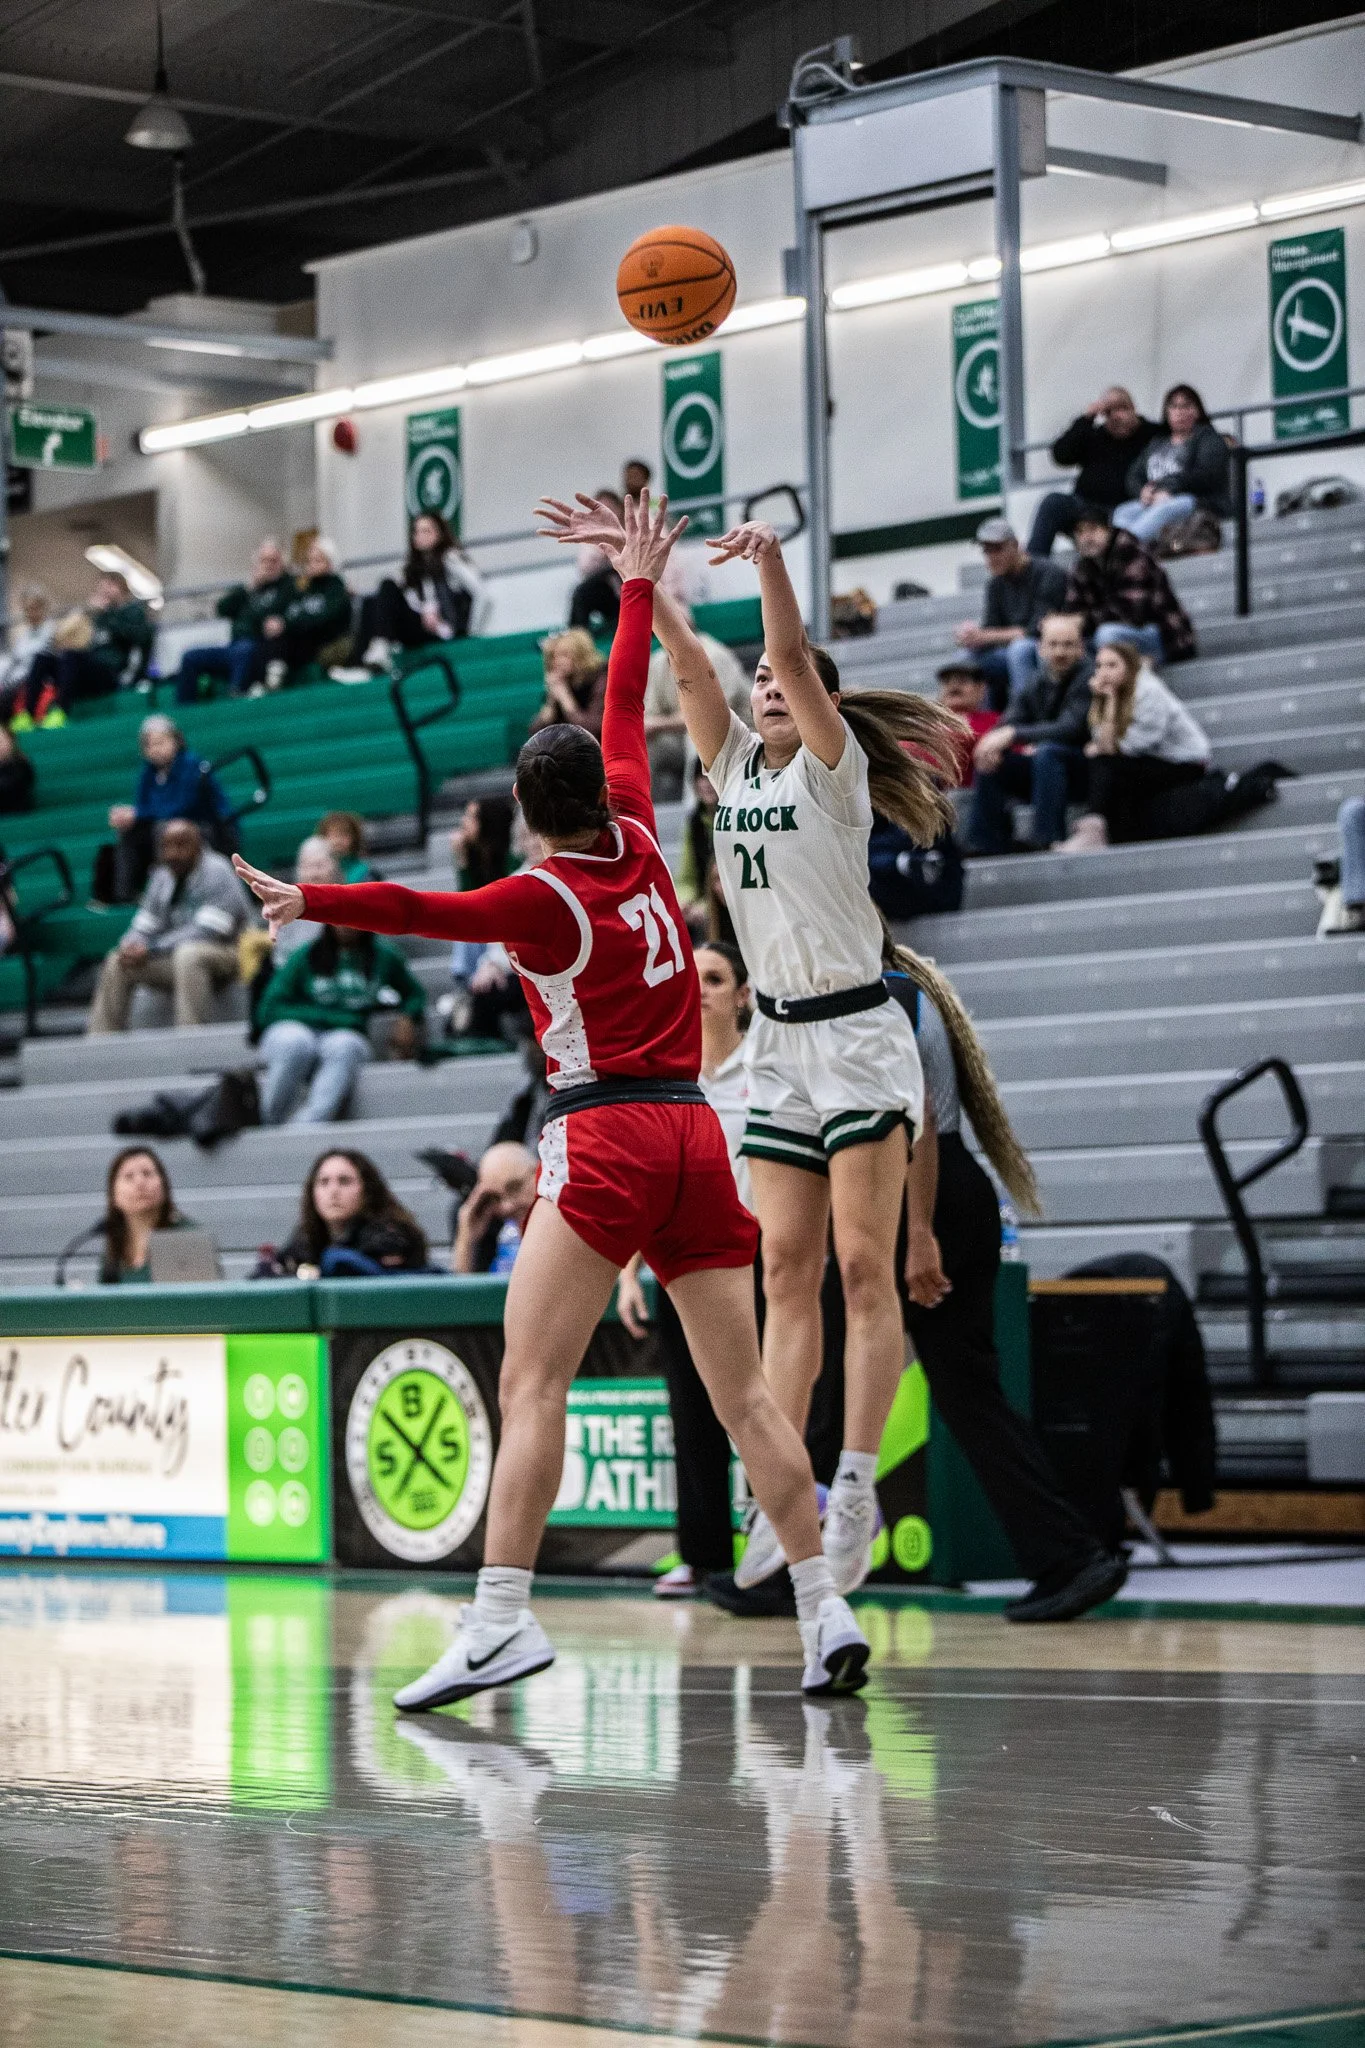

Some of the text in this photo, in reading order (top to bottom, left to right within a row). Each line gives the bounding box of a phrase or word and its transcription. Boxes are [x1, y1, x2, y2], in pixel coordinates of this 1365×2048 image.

[736, 804, 799, 833] ROCK
[734, 843, 772, 890] 21
[618, 881, 686, 989] 21
[58, 1354, 190, 1478] County
[583, 1414, 647, 1457] THE
